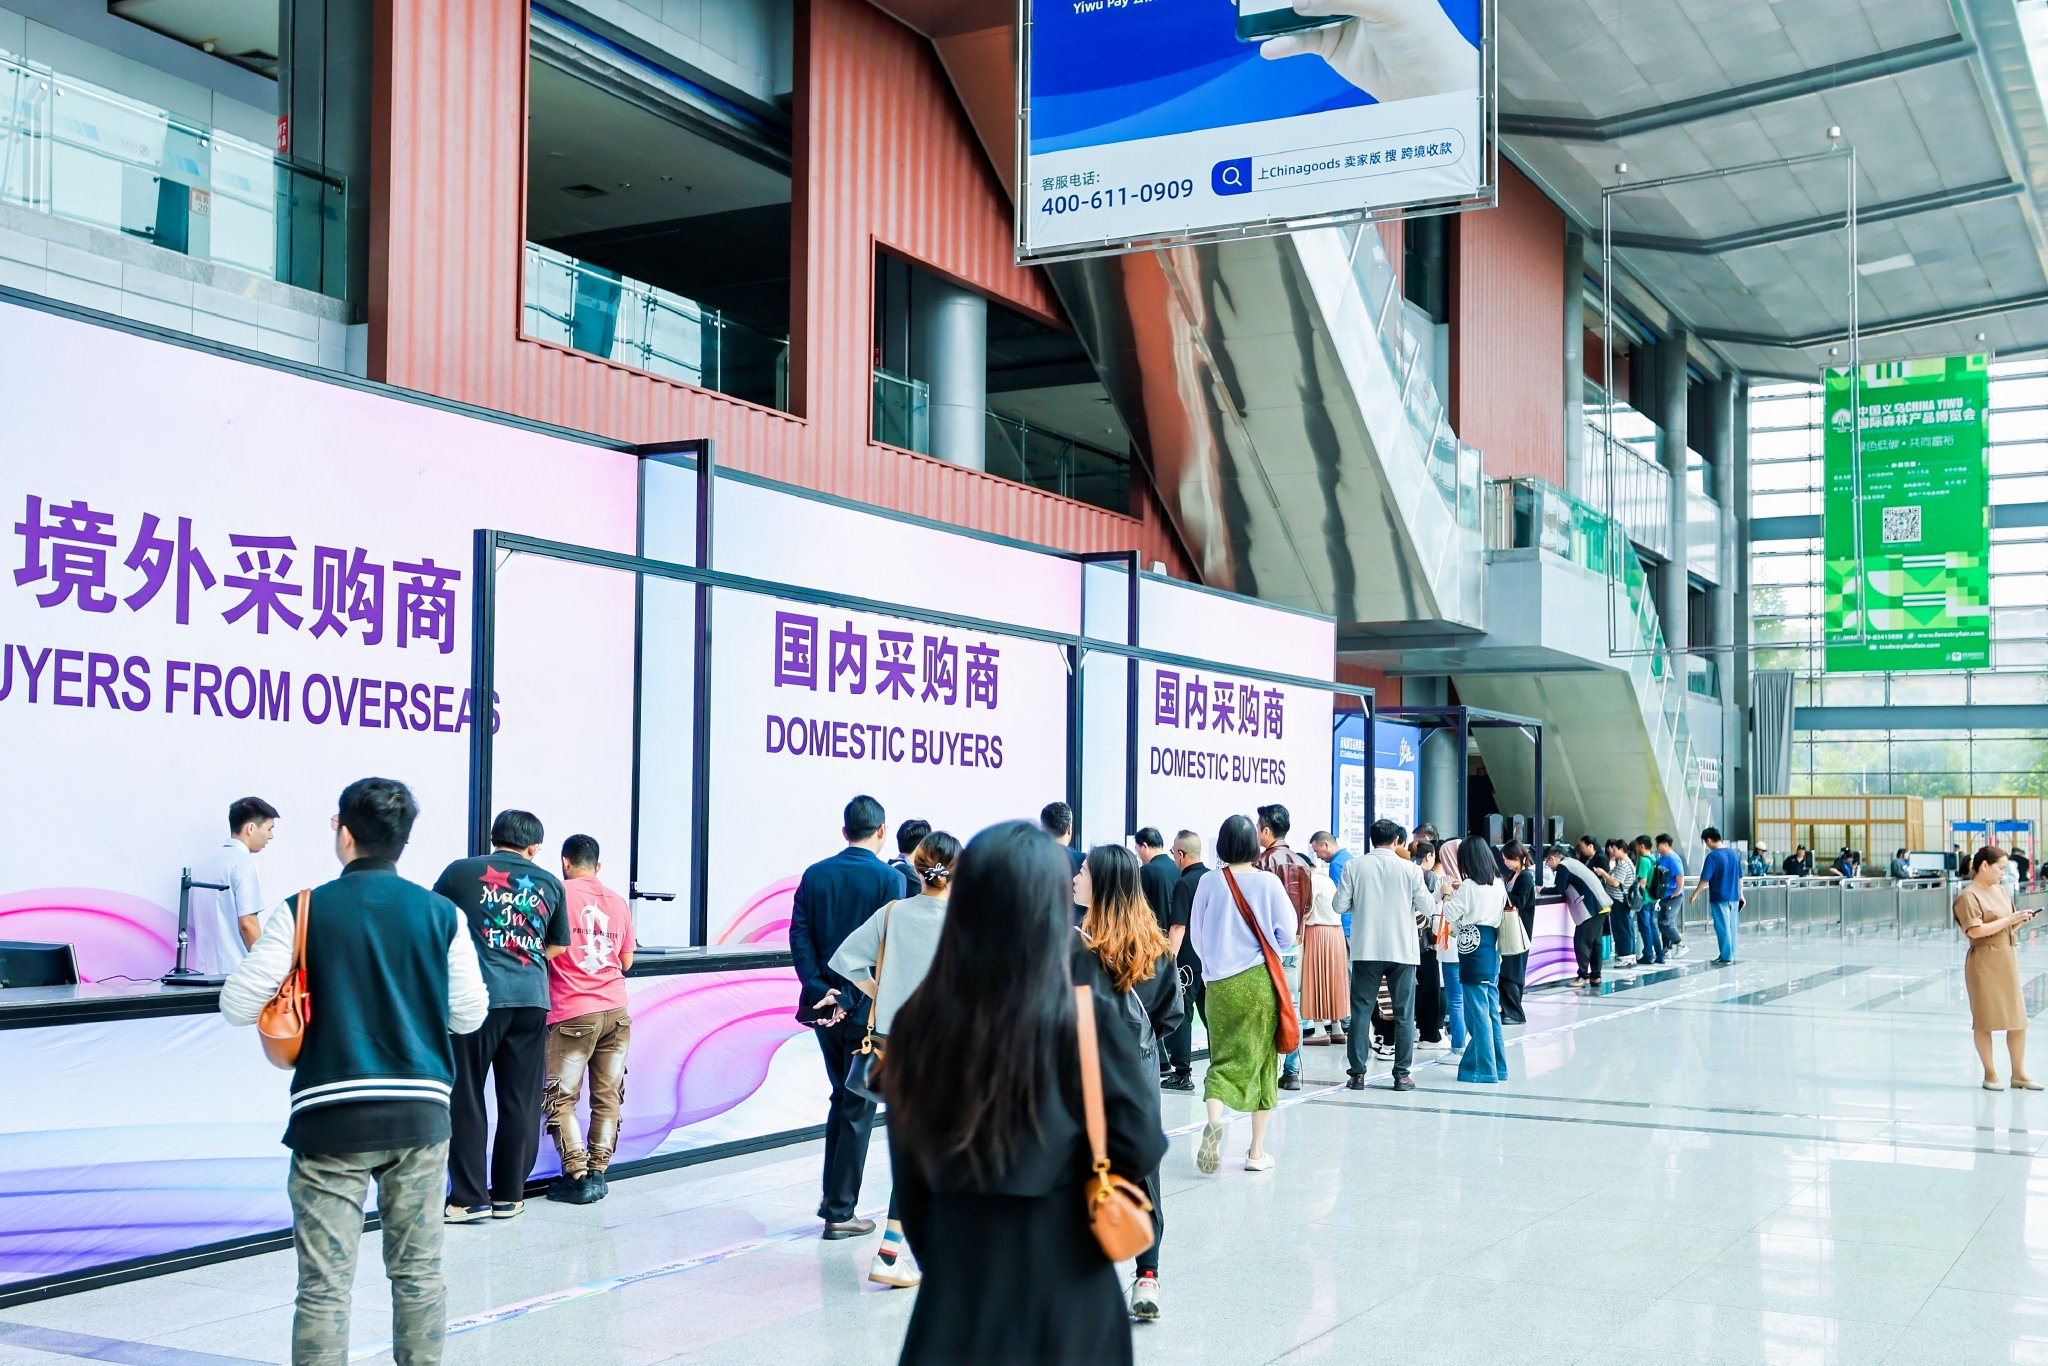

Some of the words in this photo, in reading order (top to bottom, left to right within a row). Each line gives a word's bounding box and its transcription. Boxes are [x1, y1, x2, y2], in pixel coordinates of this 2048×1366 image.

[1073, 1, 1103, 14] Yiwu
[1107, 0, 1128, 8] Pay
[1344, 151, 1381, 168] 卖家版
[1385, 149, 1397, 162] 搜
[1401, 142, 1452, 160] 跨境收款
[1041, 171, 1100, 191] 客服电话:
[1041, 179, 1193, 215] 400-611-0909
[1937, 397, 1963, 410] YIWU
[14, 494, 462, 655] 境外采购商
[774, 610, 1000, 710] 国内采购商
[165, 660, 291, 722] FROM
[1155, 669, 1284, 740] 国内采购商
[766, 714, 905, 763] DOMESTIC
[911, 728, 1003, 769] BUYERS
[1150, 746, 1230, 781] DOMESTIC
[1232, 754, 1286, 786] BUYERS
[480, 886, 540, 907] Made
[501, 905, 526, 926] In
[488, 927, 543, 951] Future
